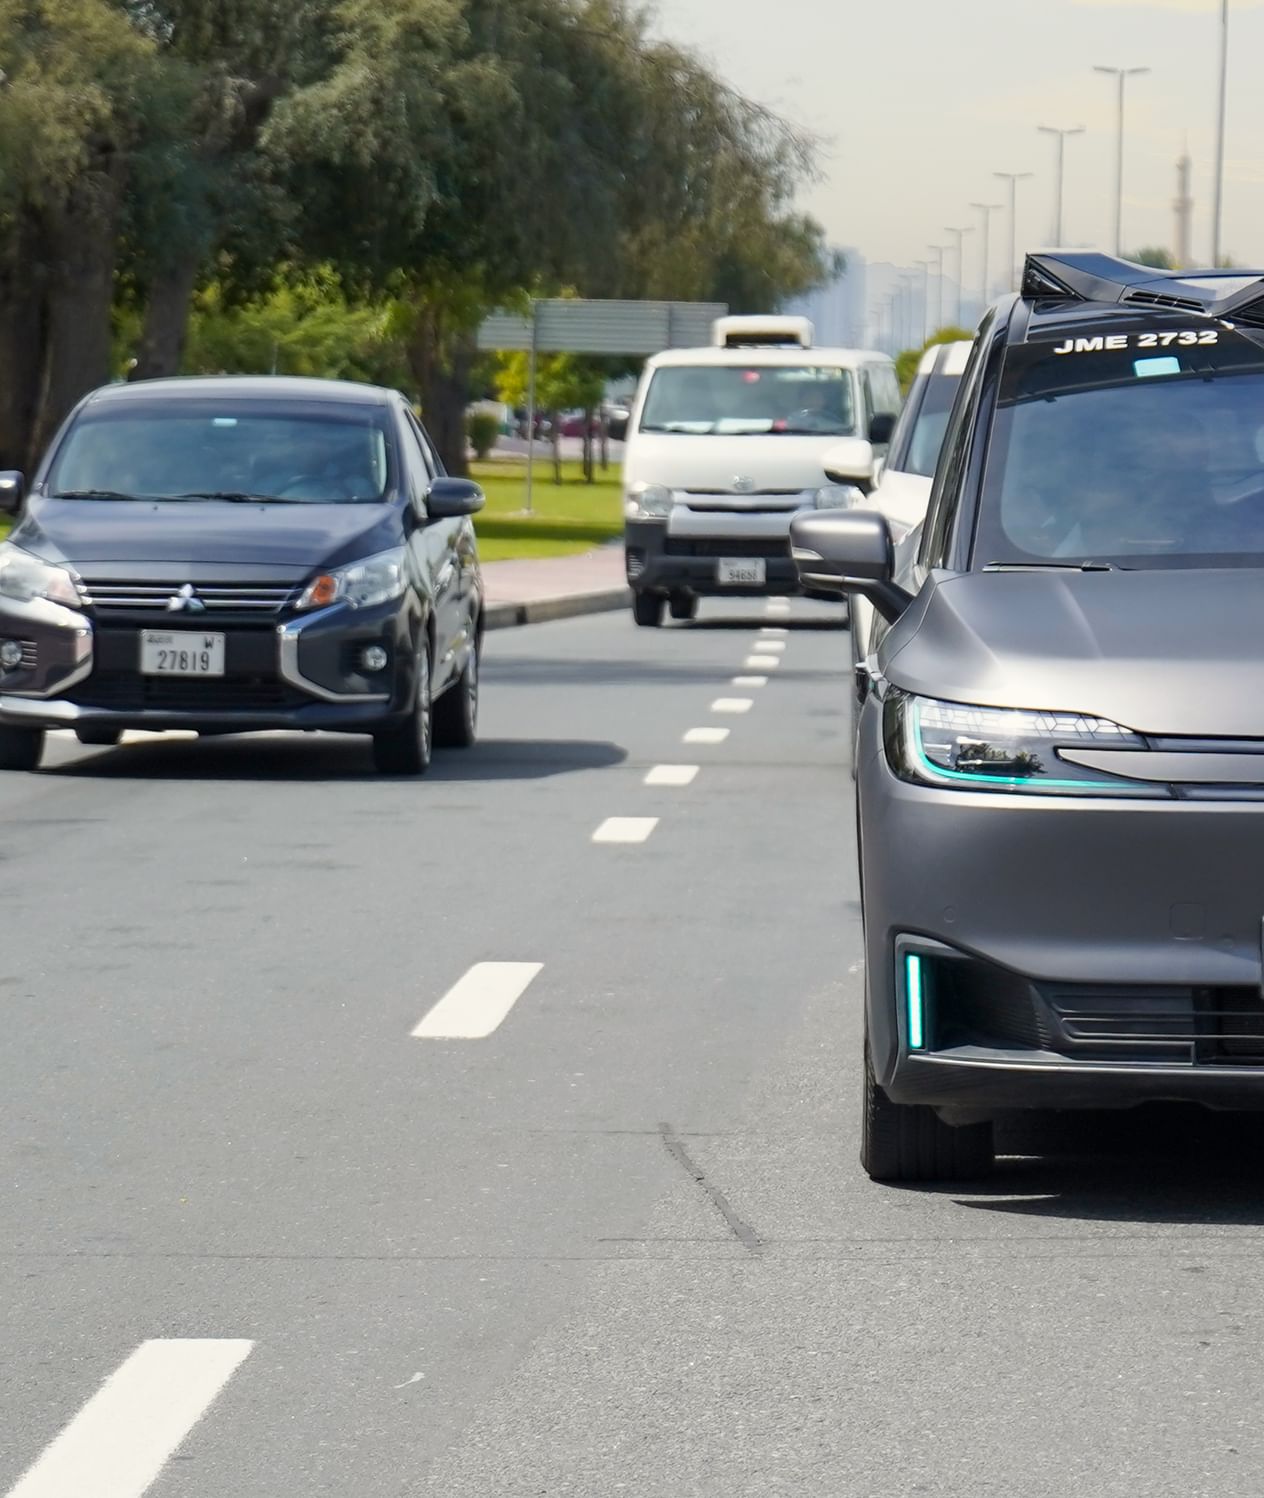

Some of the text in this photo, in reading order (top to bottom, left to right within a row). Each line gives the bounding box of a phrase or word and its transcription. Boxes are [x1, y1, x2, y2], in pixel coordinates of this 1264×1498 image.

[1053, 330, 1219, 355] JME 2732
[157, 649, 210, 671] 27819
